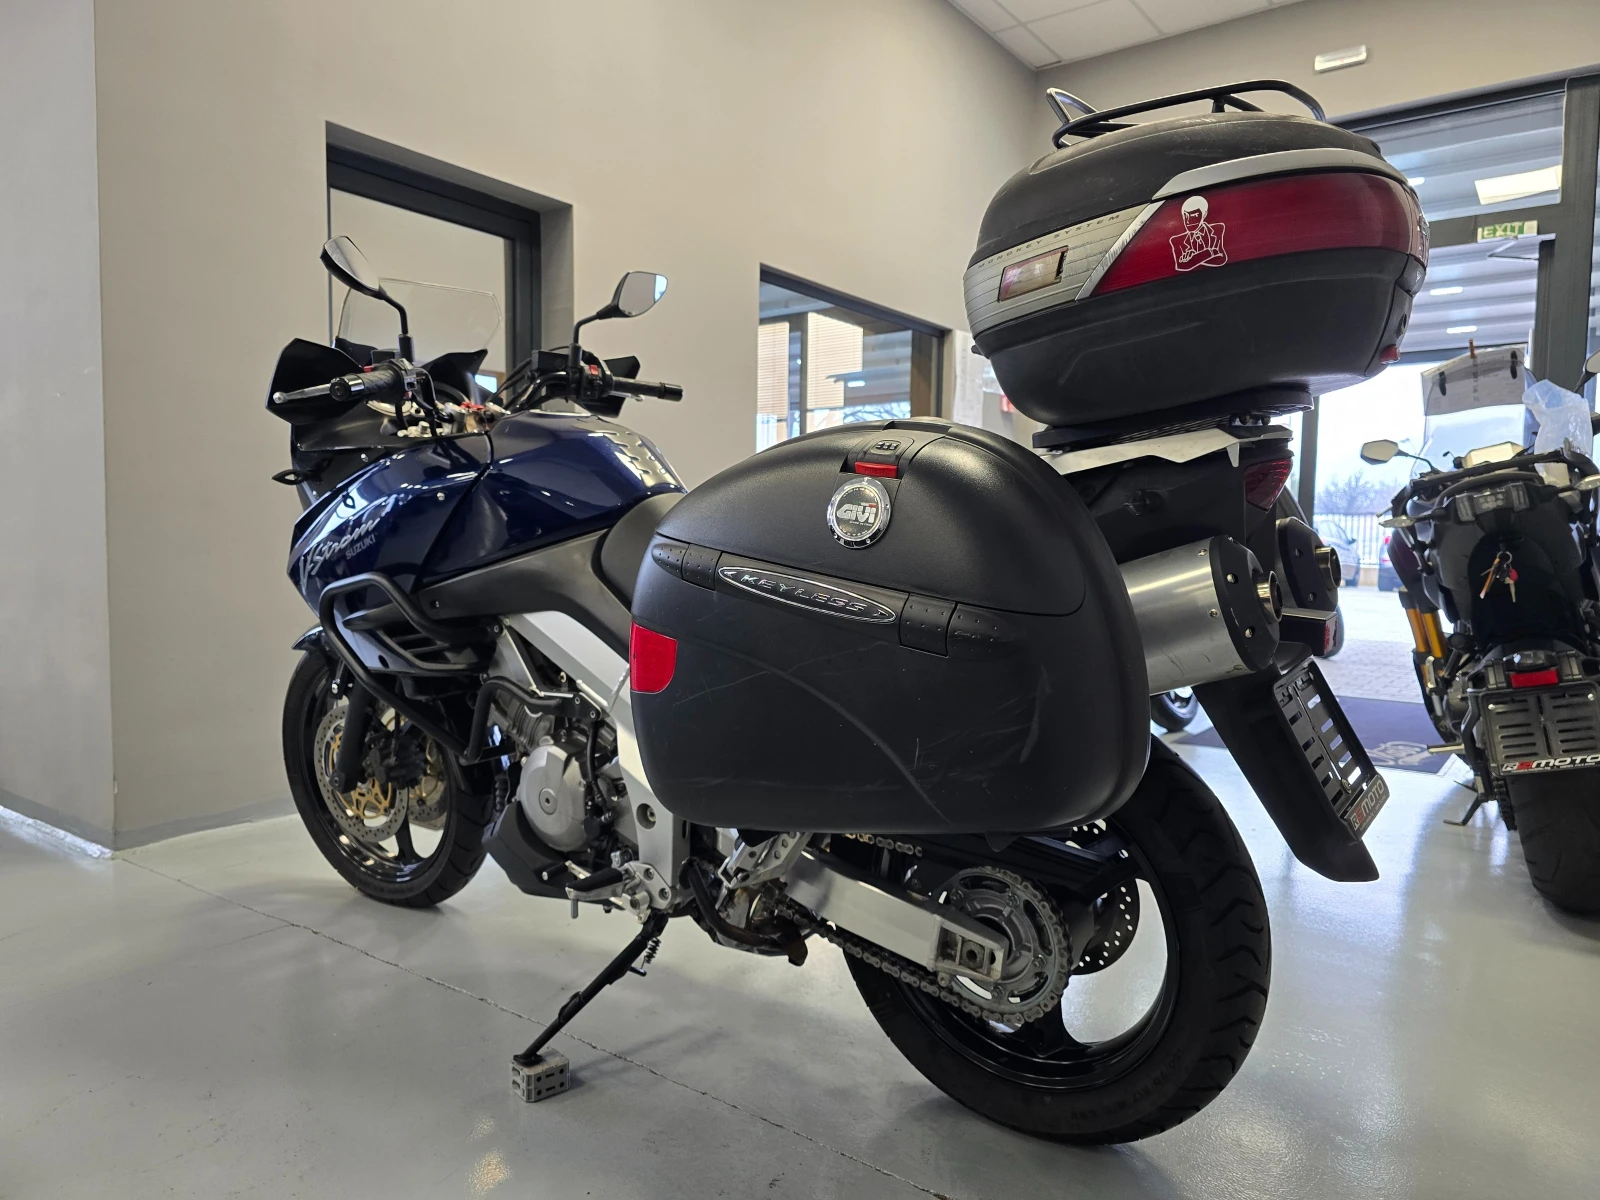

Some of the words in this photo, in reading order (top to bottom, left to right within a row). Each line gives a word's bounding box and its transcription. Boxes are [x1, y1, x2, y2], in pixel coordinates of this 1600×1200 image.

[977, 238, 1043, 270] MONOKEY
[1053, 213, 1121, 239] SYSTEM
[1482, 221, 1524, 239] EXIT
[836, 502, 877, 524] GIVI
[345, 533, 377, 560] SUZUKI
[740, 573, 868, 612] KEYLESS
